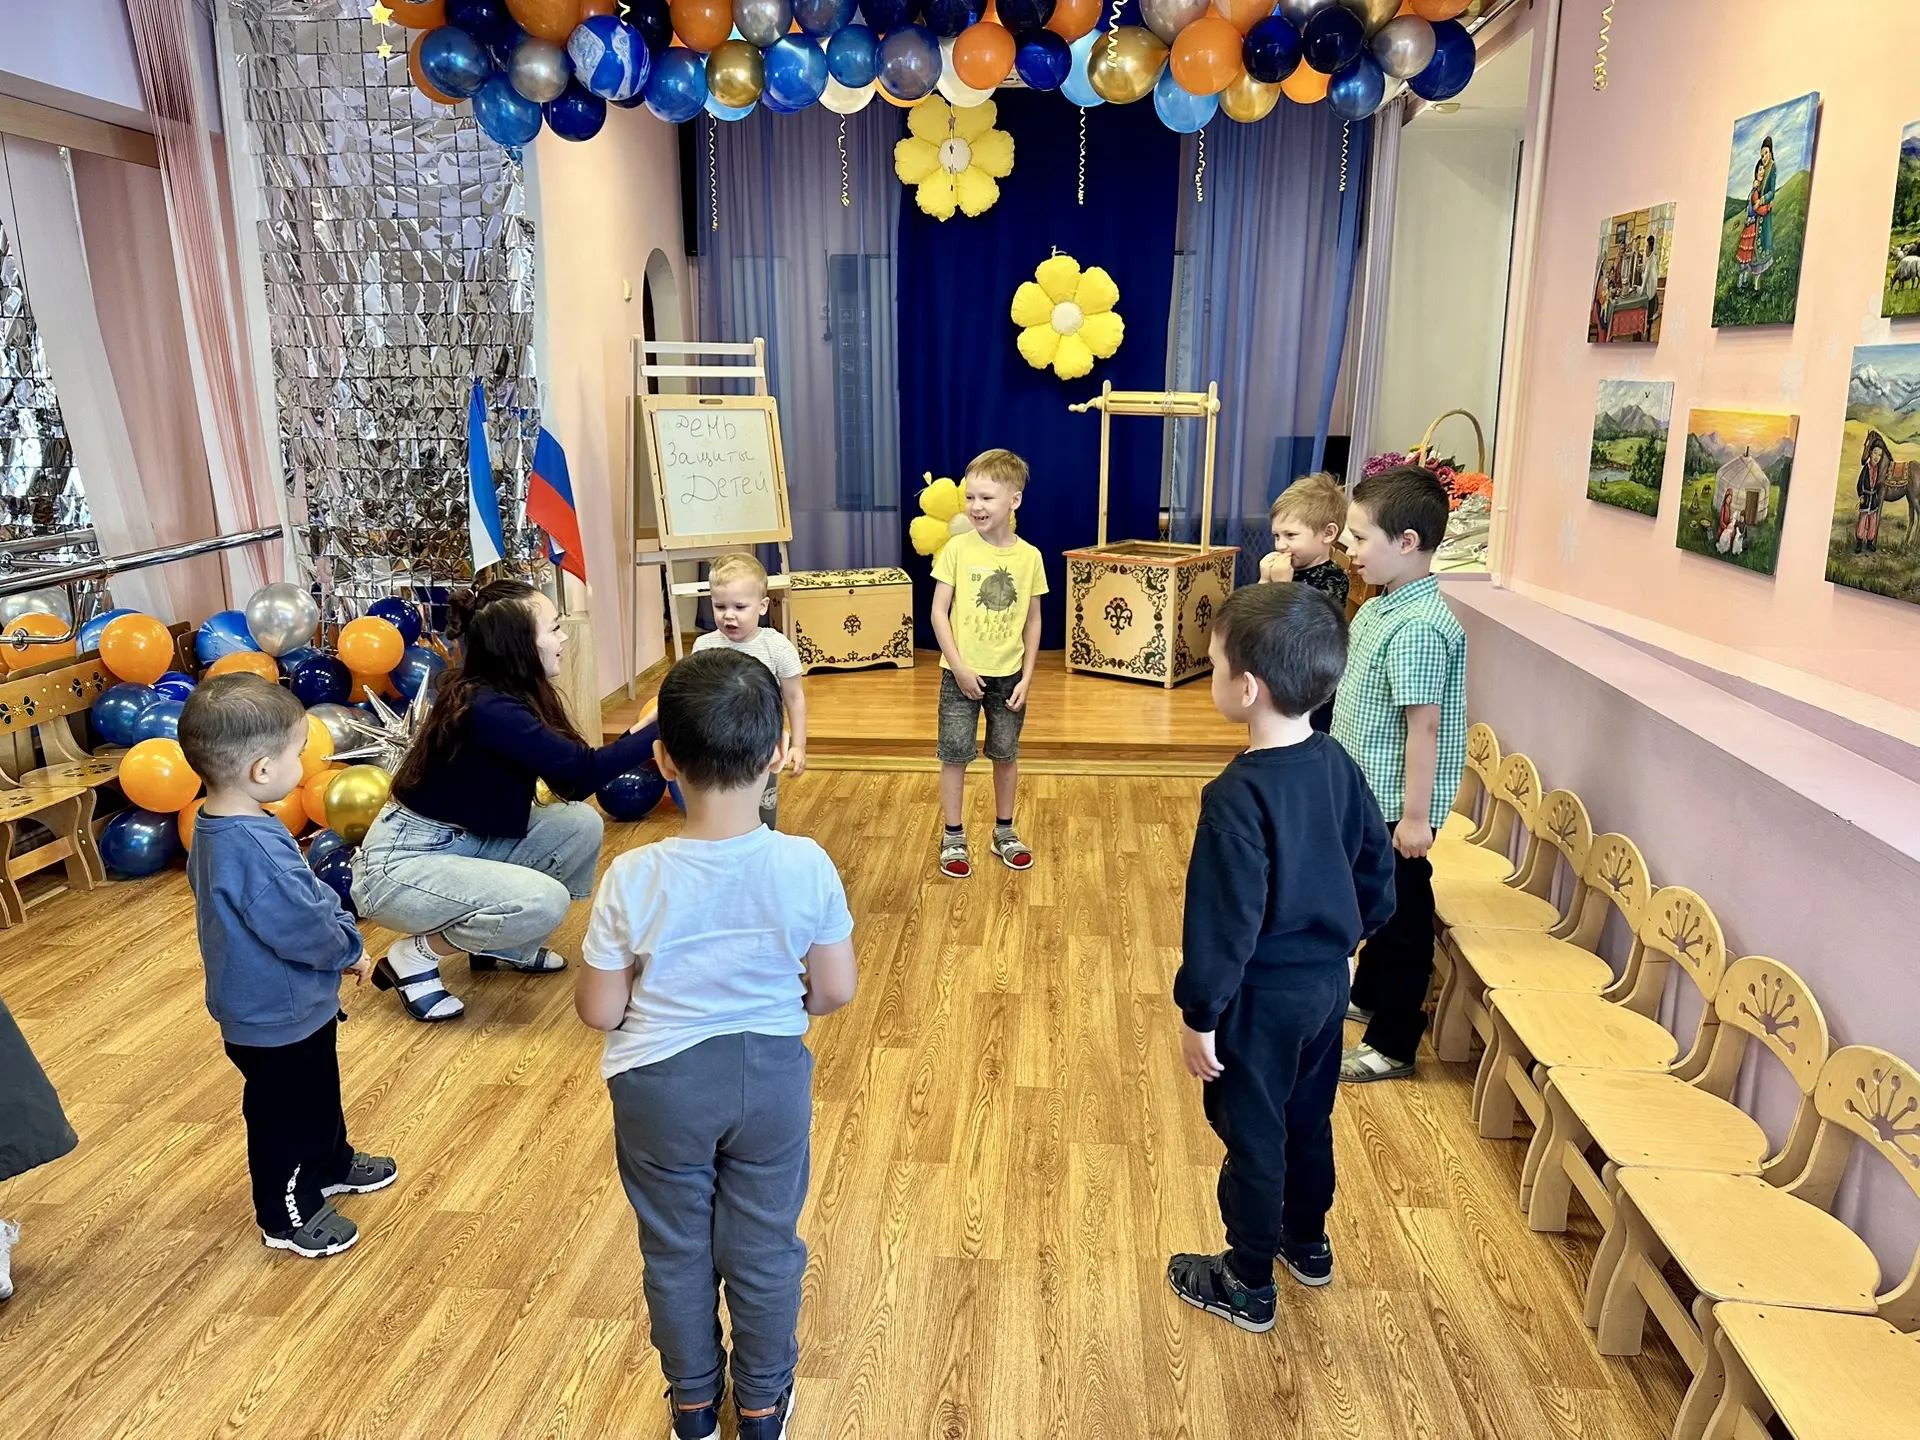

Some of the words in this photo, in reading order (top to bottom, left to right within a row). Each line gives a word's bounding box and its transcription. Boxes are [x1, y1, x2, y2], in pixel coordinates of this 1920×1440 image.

[667, 441, 755, 467] Защиты
[680, 471, 769, 505] Детей
[971, 573, 982, 582] 89
